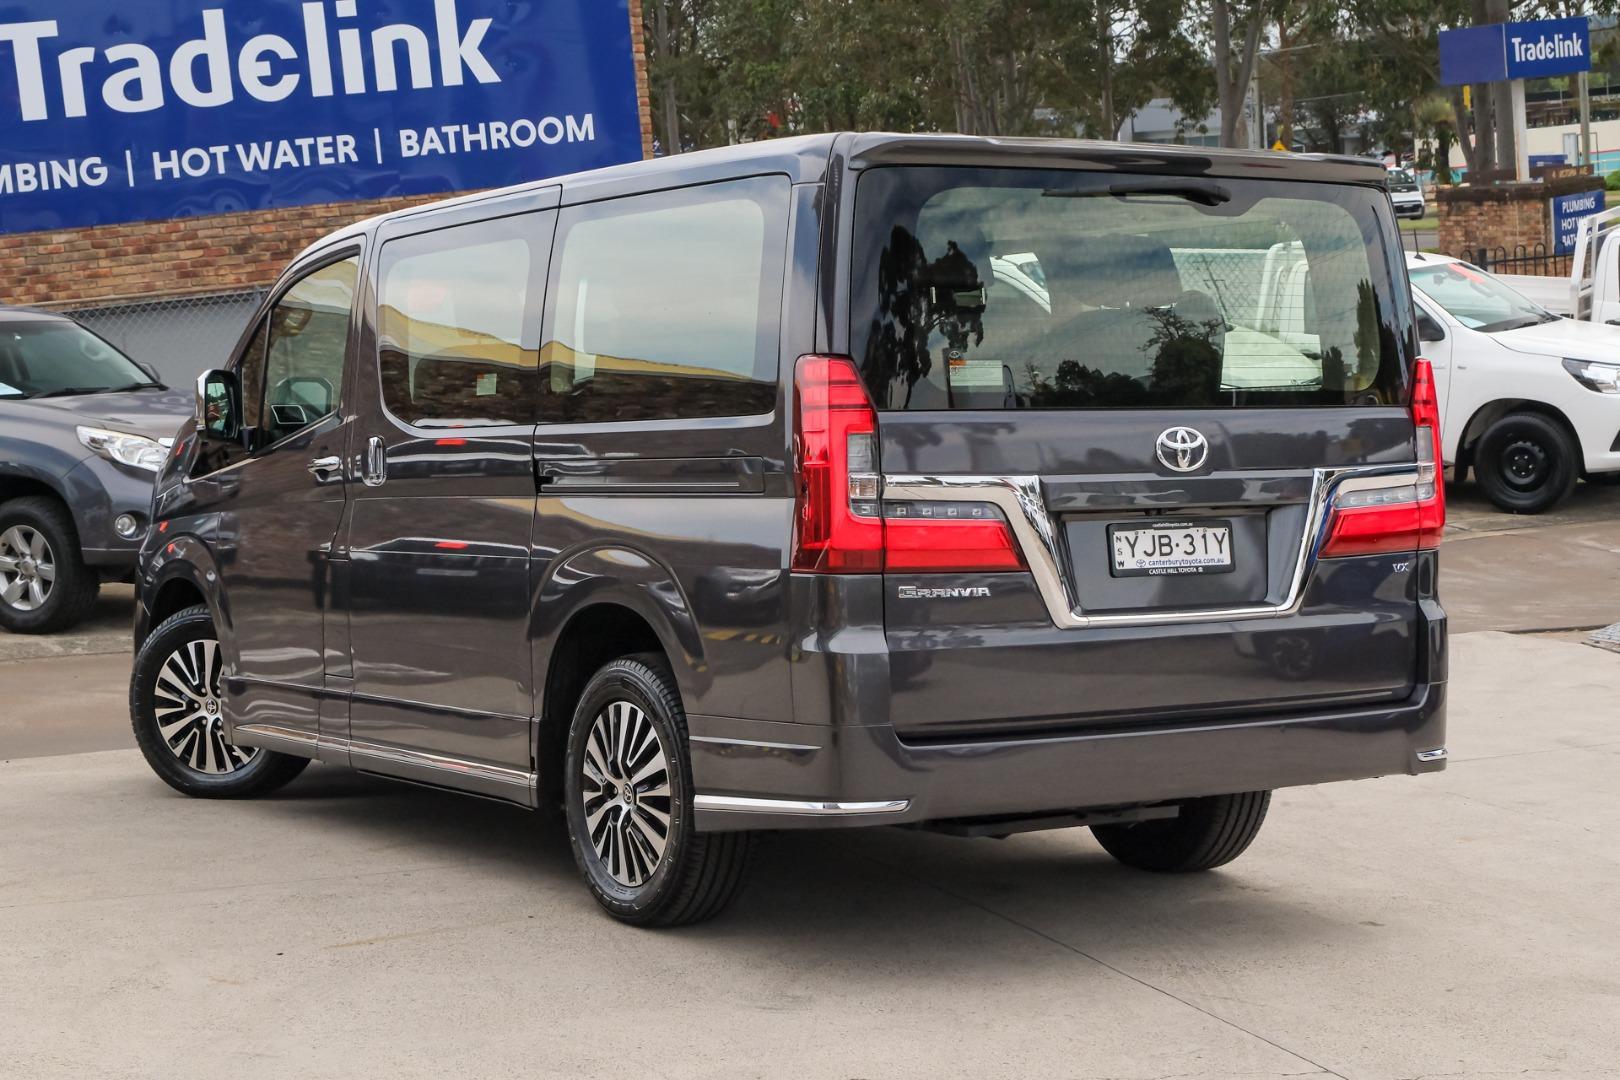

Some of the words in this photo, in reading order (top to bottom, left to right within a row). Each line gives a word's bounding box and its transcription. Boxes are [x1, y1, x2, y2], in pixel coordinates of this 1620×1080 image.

[1511, 32, 1583, 62] Tradelink
[0, 0, 501, 122] Tradelink
[152, 145, 230, 181] HOT
[235, 134, 359, 172] WATER
[399, 113, 595, 158] BATHROOM
[1562, 197, 1595, 213] PLUMBING
[1561, 216, 1576, 230] HOT
[1148, 558, 1225, 567] canterburytoyota.com.au
[898, 585, 991, 598] GRANVIA
